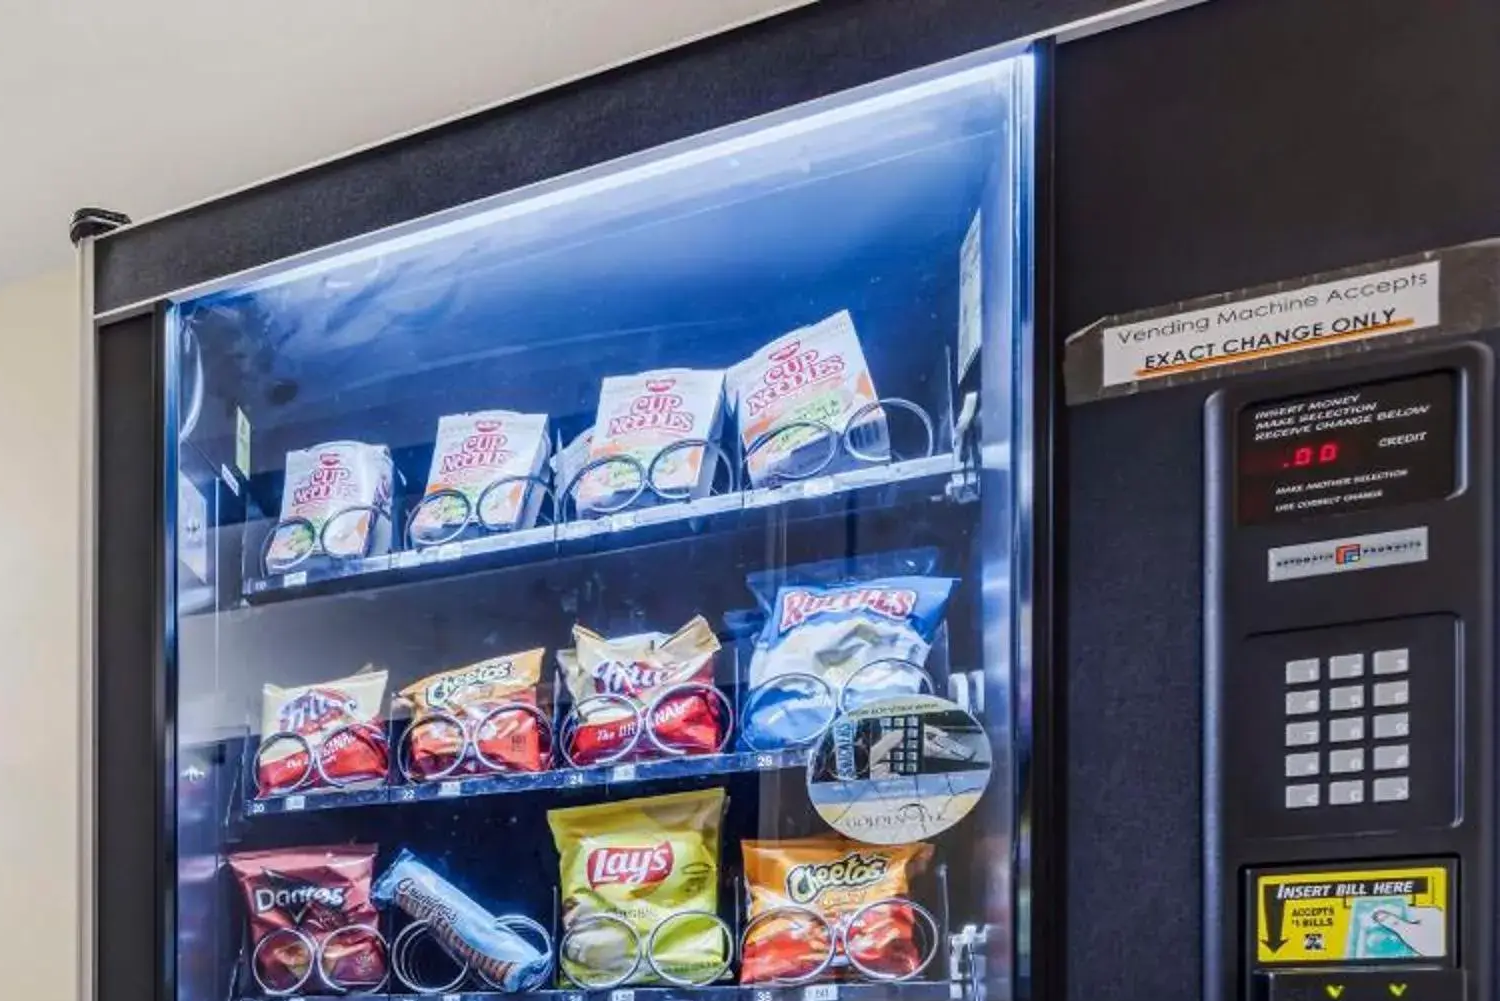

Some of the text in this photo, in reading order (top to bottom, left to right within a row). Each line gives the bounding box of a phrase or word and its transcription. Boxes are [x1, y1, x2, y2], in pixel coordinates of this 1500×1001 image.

[1118, 272, 1428, 344] Vending Machine Accepts
[1145, 307, 1396, 369] EXACT CHANGE ONLY
[764, 349, 819, 386] CUP
[630, 394, 684, 416] CUP
[1255, 393, 1361, 420] INSERT MONEY
[1255, 402, 1378, 431] MAKE SELECTION
[1254, 404, 1431, 441] RECEIVE CHANGE BELOW
[1378, 431, 1428, 448] CREDIT
[256, 886, 344, 912] Doritos
[1277, 880, 1415, 899] INSERT BILL HERE
[1291, 906, 1334, 918] ACCEPTS
[1302, 917, 1334, 928] BILLS
